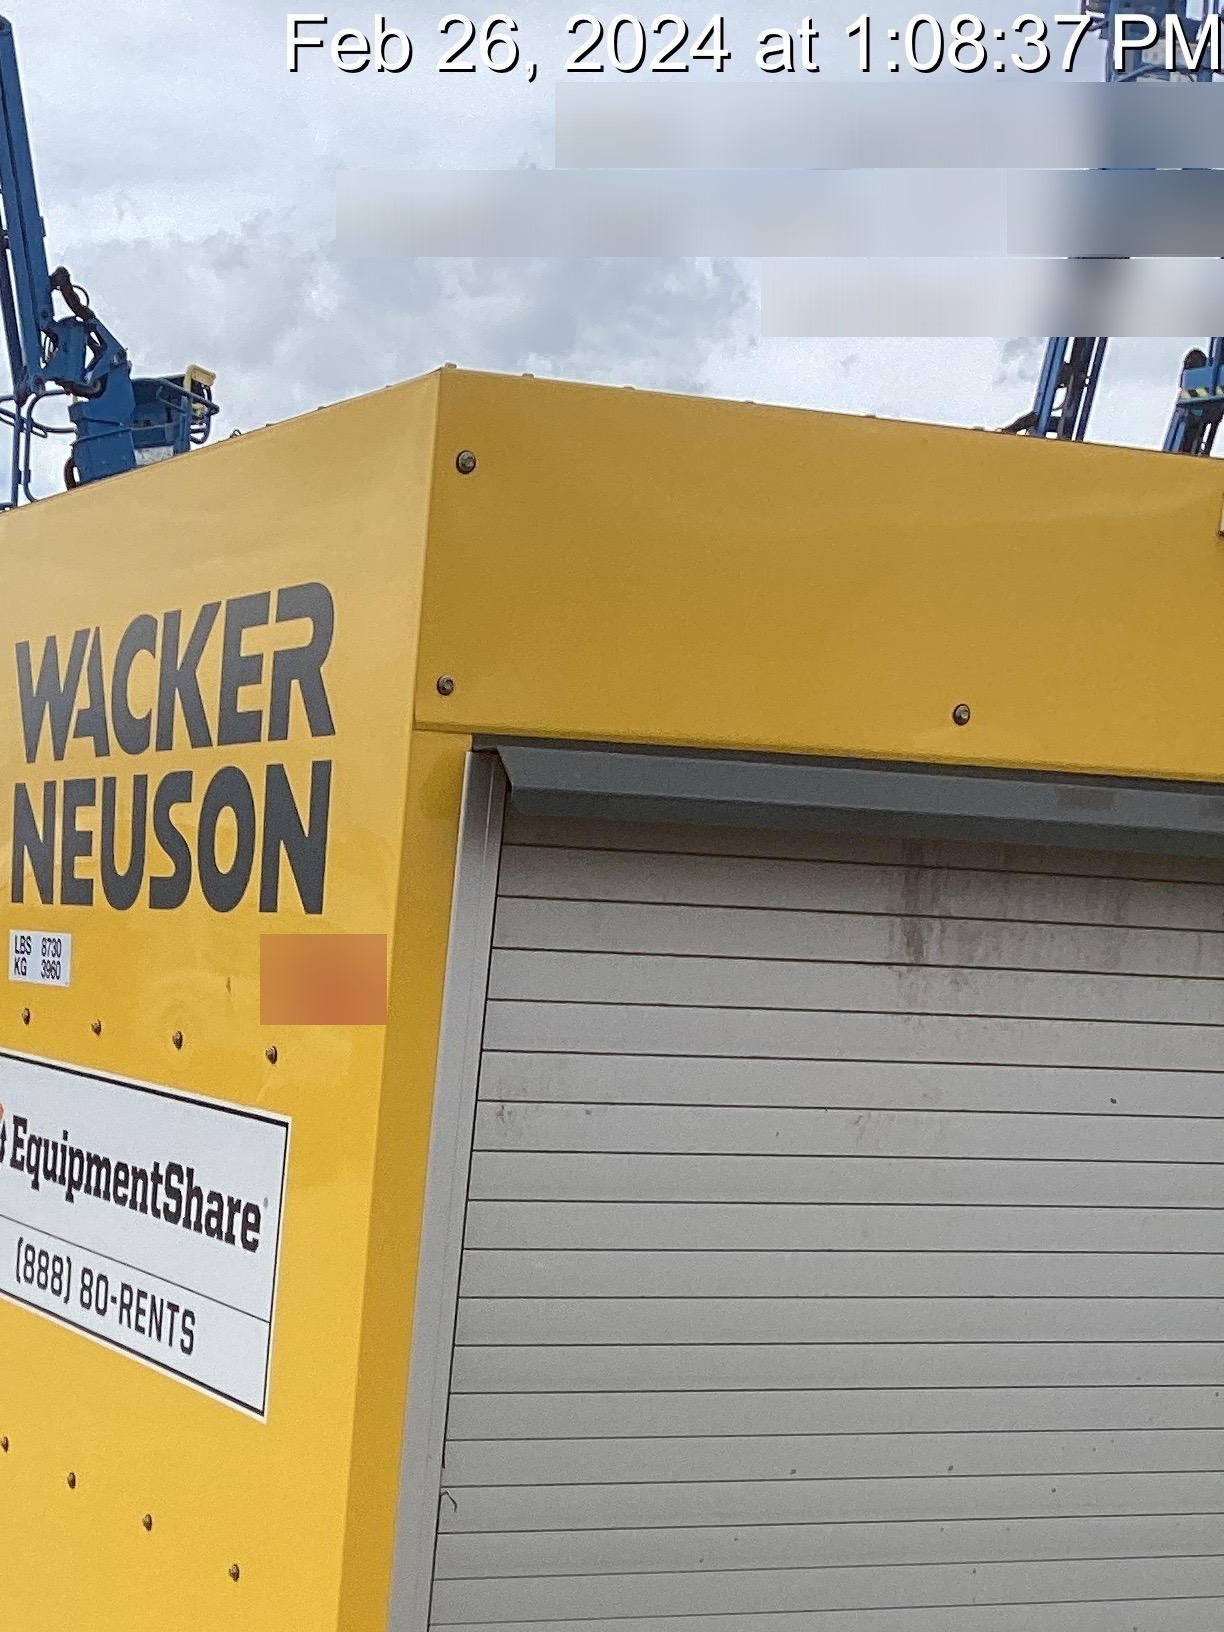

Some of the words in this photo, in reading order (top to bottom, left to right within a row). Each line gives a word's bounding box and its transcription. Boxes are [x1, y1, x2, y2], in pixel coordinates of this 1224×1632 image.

[15, 582, 336, 764] WACKER
[11, 759, 332, 915] NEUSON
[14, 935, 32, 955] LBS
[41, 937, 62, 958] 8730
[14, 957, 27, 976] KG
[41, 959, 61, 980] 3960
[9, 1115, 262, 1253] EquipmentShare
[15, 1237, 72, 1304] (888)
[79, 1267, 196, 1355] 80-RENTS
